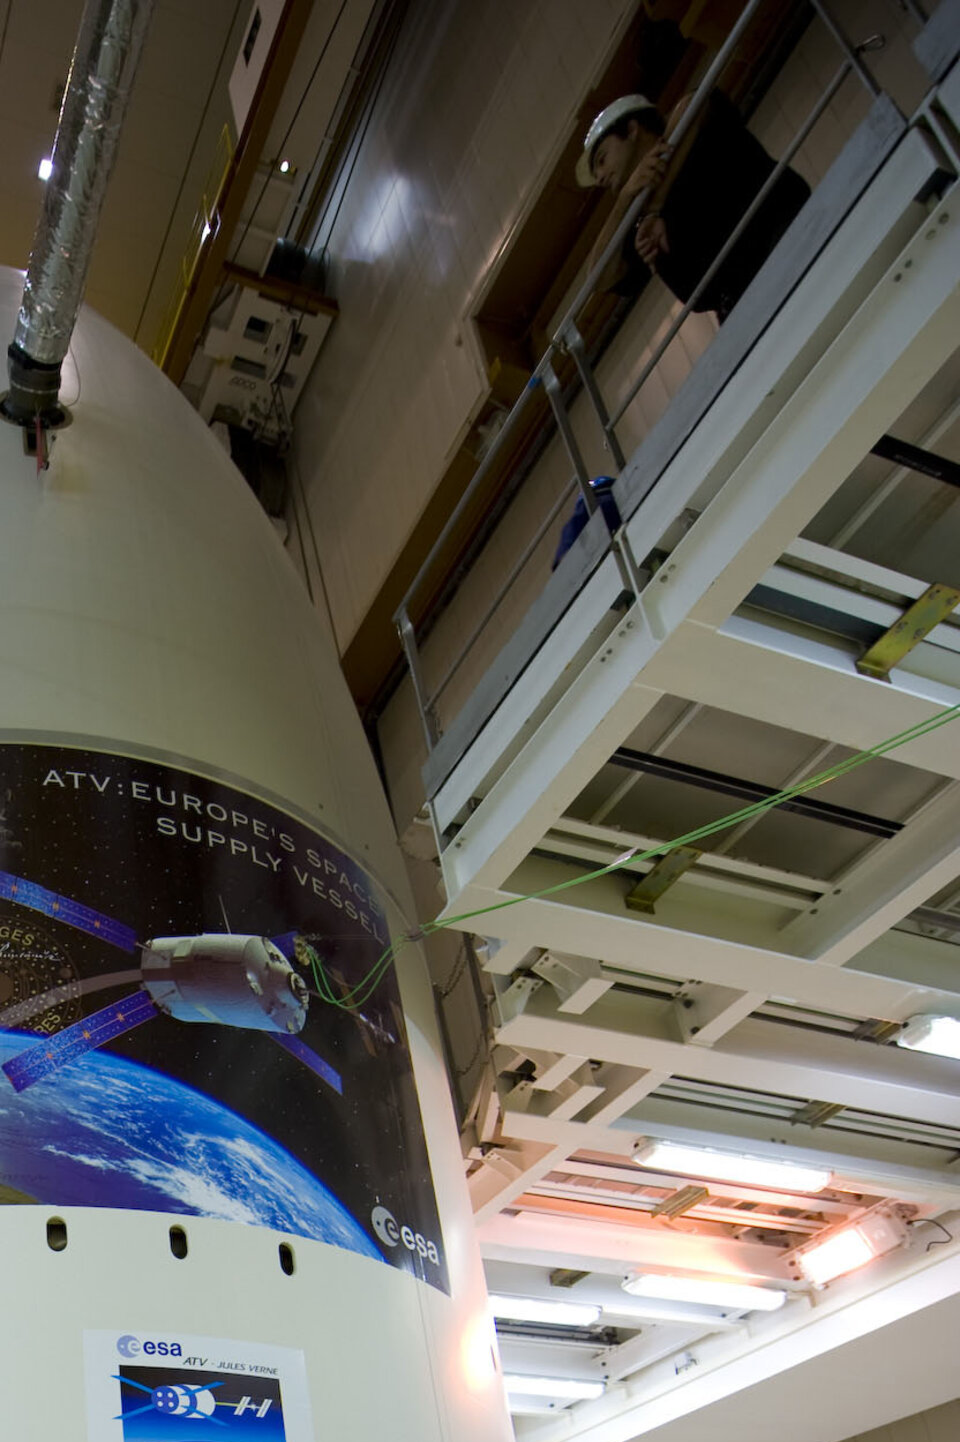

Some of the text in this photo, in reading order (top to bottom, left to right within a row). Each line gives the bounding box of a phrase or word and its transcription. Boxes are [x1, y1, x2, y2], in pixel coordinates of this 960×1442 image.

[156, 817, 385, 946] SUPPLY VESSEL
[306, 848, 380, 917] SPACE
[400, 1225, 440, 1266] esa
[143, 1340, 183, 1357] esa
[183, 1356, 209, 1367] ATV
[217, 1361, 247, 1372] JULES
[248, 1364, 280, 1376] VERNE
